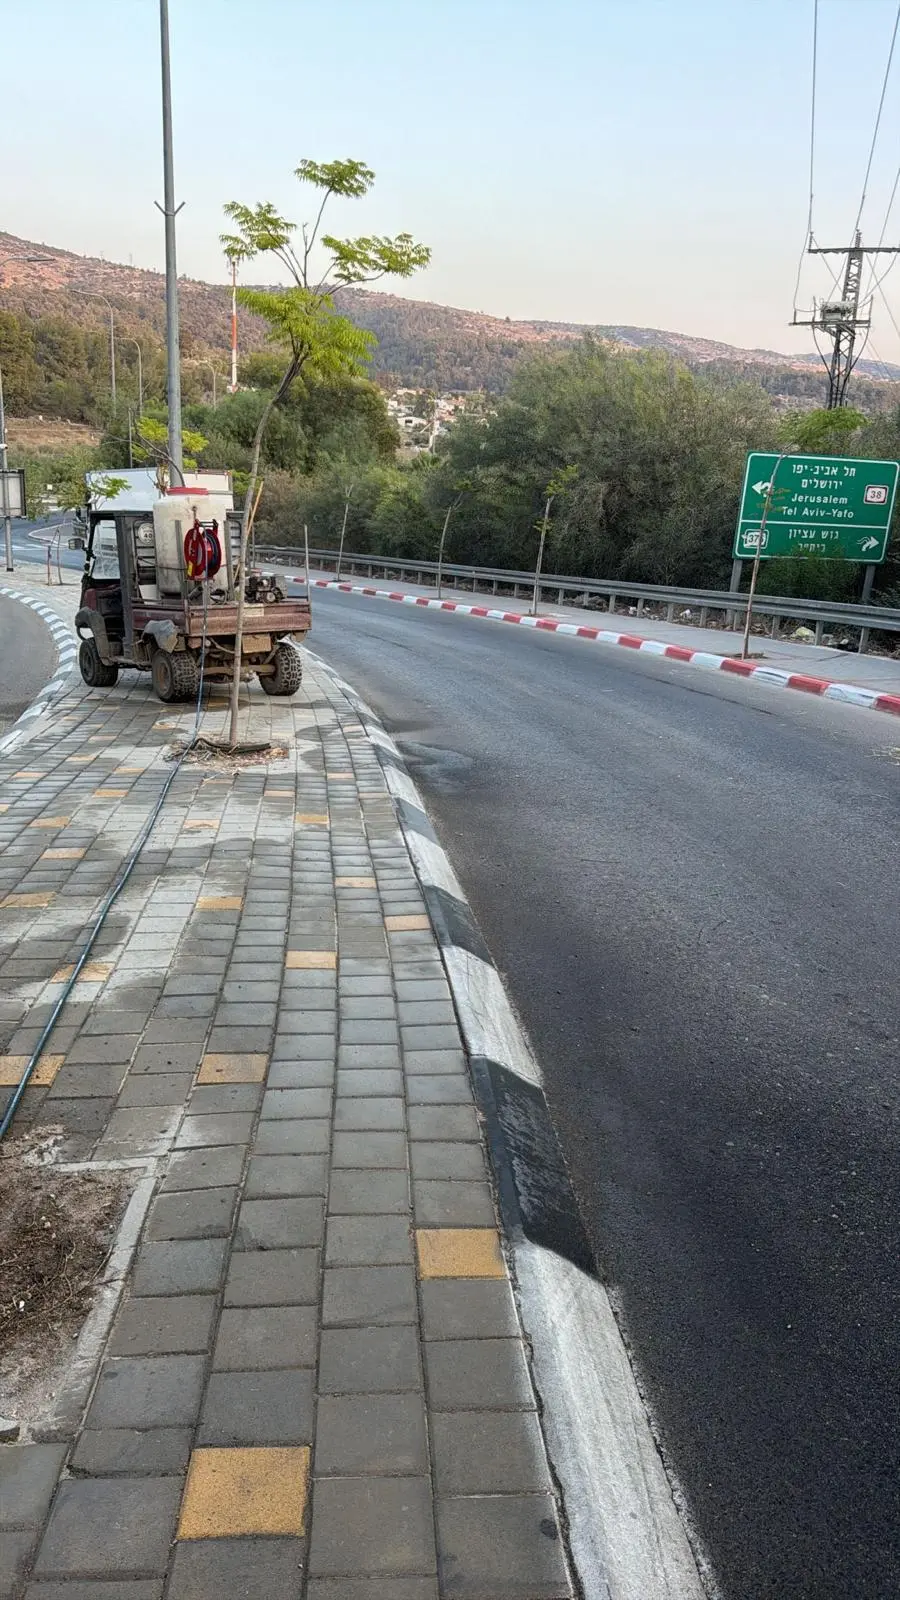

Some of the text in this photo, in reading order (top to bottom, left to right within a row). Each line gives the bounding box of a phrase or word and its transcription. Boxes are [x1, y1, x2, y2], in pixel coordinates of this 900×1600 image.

[792, 464, 856, 477] תל אביב-יפו
[801, 478, 843, 490] ירושלים
[791, 493, 848, 504] Jerusalem
[870, 490, 882, 499] 38
[782, 506, 854, 519] Tel Aviv-Yafo
[789, 528, 839, 540] גוש עציון
